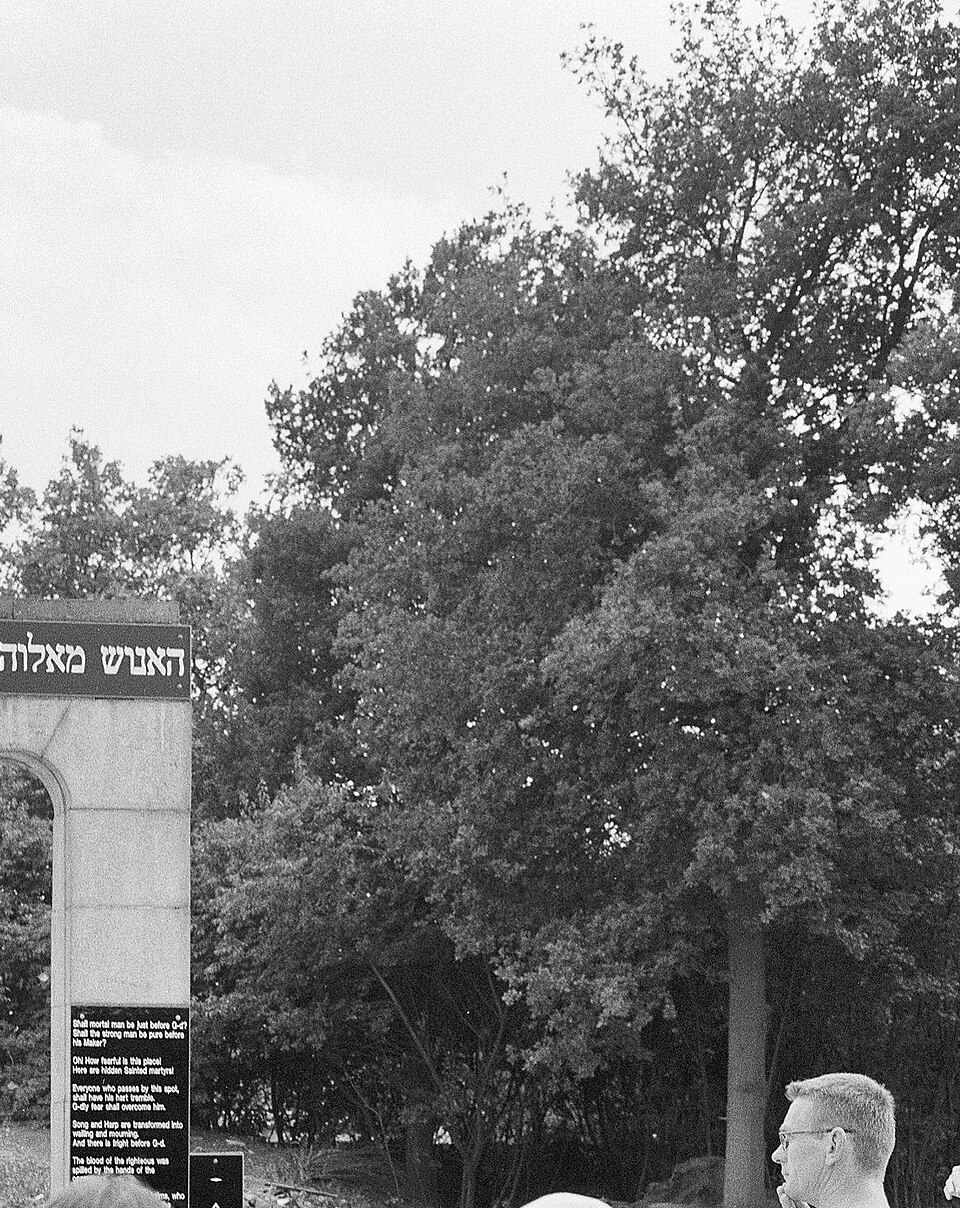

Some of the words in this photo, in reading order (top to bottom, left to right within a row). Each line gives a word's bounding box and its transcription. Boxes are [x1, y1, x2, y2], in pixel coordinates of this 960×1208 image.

[100, 643, 186, 677] האנוש
[73, 1019, 88, 1028] Shall
[90, 1020, 110, 1029] mortal
[127, 1021, 135, 1029] be
[137, 1021, 149, 1030] just
[150, 1021, 170, 1029] before
[73, 1030, 88, 1038] Shall
[90, 1030, 100, 1038] the
[102, 1030, 122, 1040] strong
[139, 1030, 147, 1039] be
[149, 1032, 163, 1040] pure
[165, 1031, 185, 1039] before
[73, 1038, 82, 1047] his
[84, 1039, 107, 1047] Maker?
[73, 1056, 84, 1065] Oh!
[85, 1057, 99, 1065] How
[101, 1057, 121, 1065] fearful
[123, 1057, 128, 1065] is
[130, 1057, 141, 1065] this
[73, 1066, 87, 1074] Here
[124, 1067, 147, 1075] Sainted
[72, 1084, 100, 1093] Everyone
[118, 1086, 140, 1094] passes
[141, 1085, 149, 1094] by
[151, 1085, 162, 1093] this
[73, 1094, 87, 1102] shall
[89, 1094, 103, 1102] have
[105, 1094, 114, 1102] his
[91, 1103, 103, 1111] fear
[106, 1103, 120, 1111] shall
[72, 1120, 89, 1129] Song
[91, 1120, 102, 1129] and
[104, 1121, 119, 1130] Harp
[133, 1121, 170, 1129] transformed
[172, 1121, 183, 1129] into
[72, 1130, 94, 1139] wailing
[96, 1130, 107, 1138] and
[73, 1139, 85, 1147] And
[87, 1140, 103, 1148] there
[113, 1140, 129, 1149] fright
[131, 1140, 150, 1148] before
[73, 1157, 85, 1165] The
[87, 1157, 104, 1165] blood
[106, 1157, 112, 1165] of
[114, 1157, 124, 1165] the
[126, 1158, 155, 1166] righteous
[116, 1166, 134, 1175] hands
[145, 1167, 155, 1175] the
